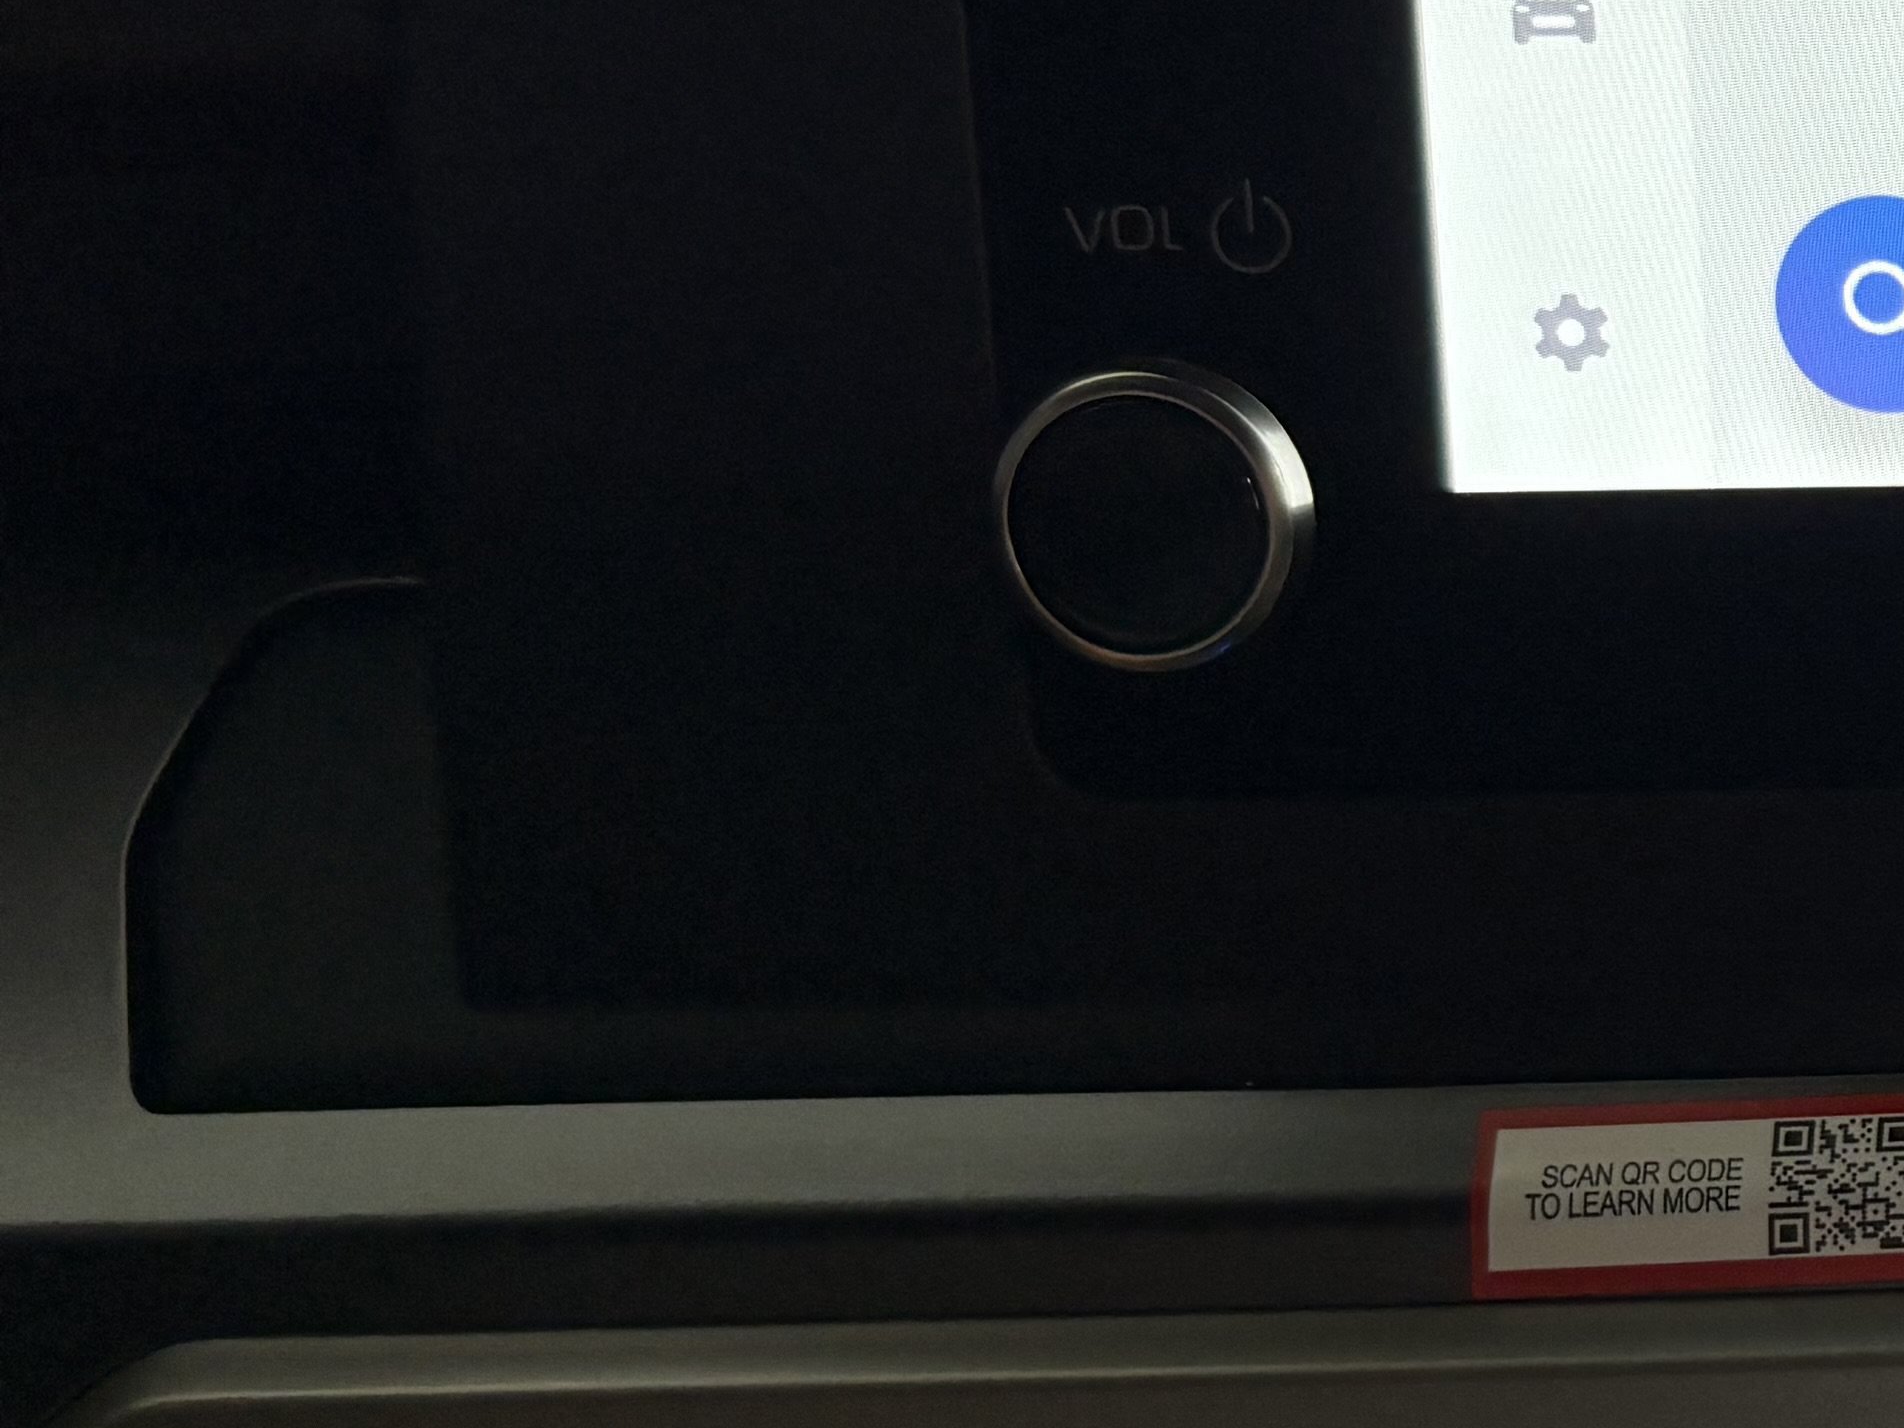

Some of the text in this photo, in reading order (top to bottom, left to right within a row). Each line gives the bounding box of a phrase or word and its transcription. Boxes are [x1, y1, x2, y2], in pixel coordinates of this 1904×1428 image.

[1065, 206, 1183, 252] VOL
[1542, 1157, 1744, 1188] SCAN QR CODE
[1526, 1184, 1741, 1220] TO LEARN MORE
